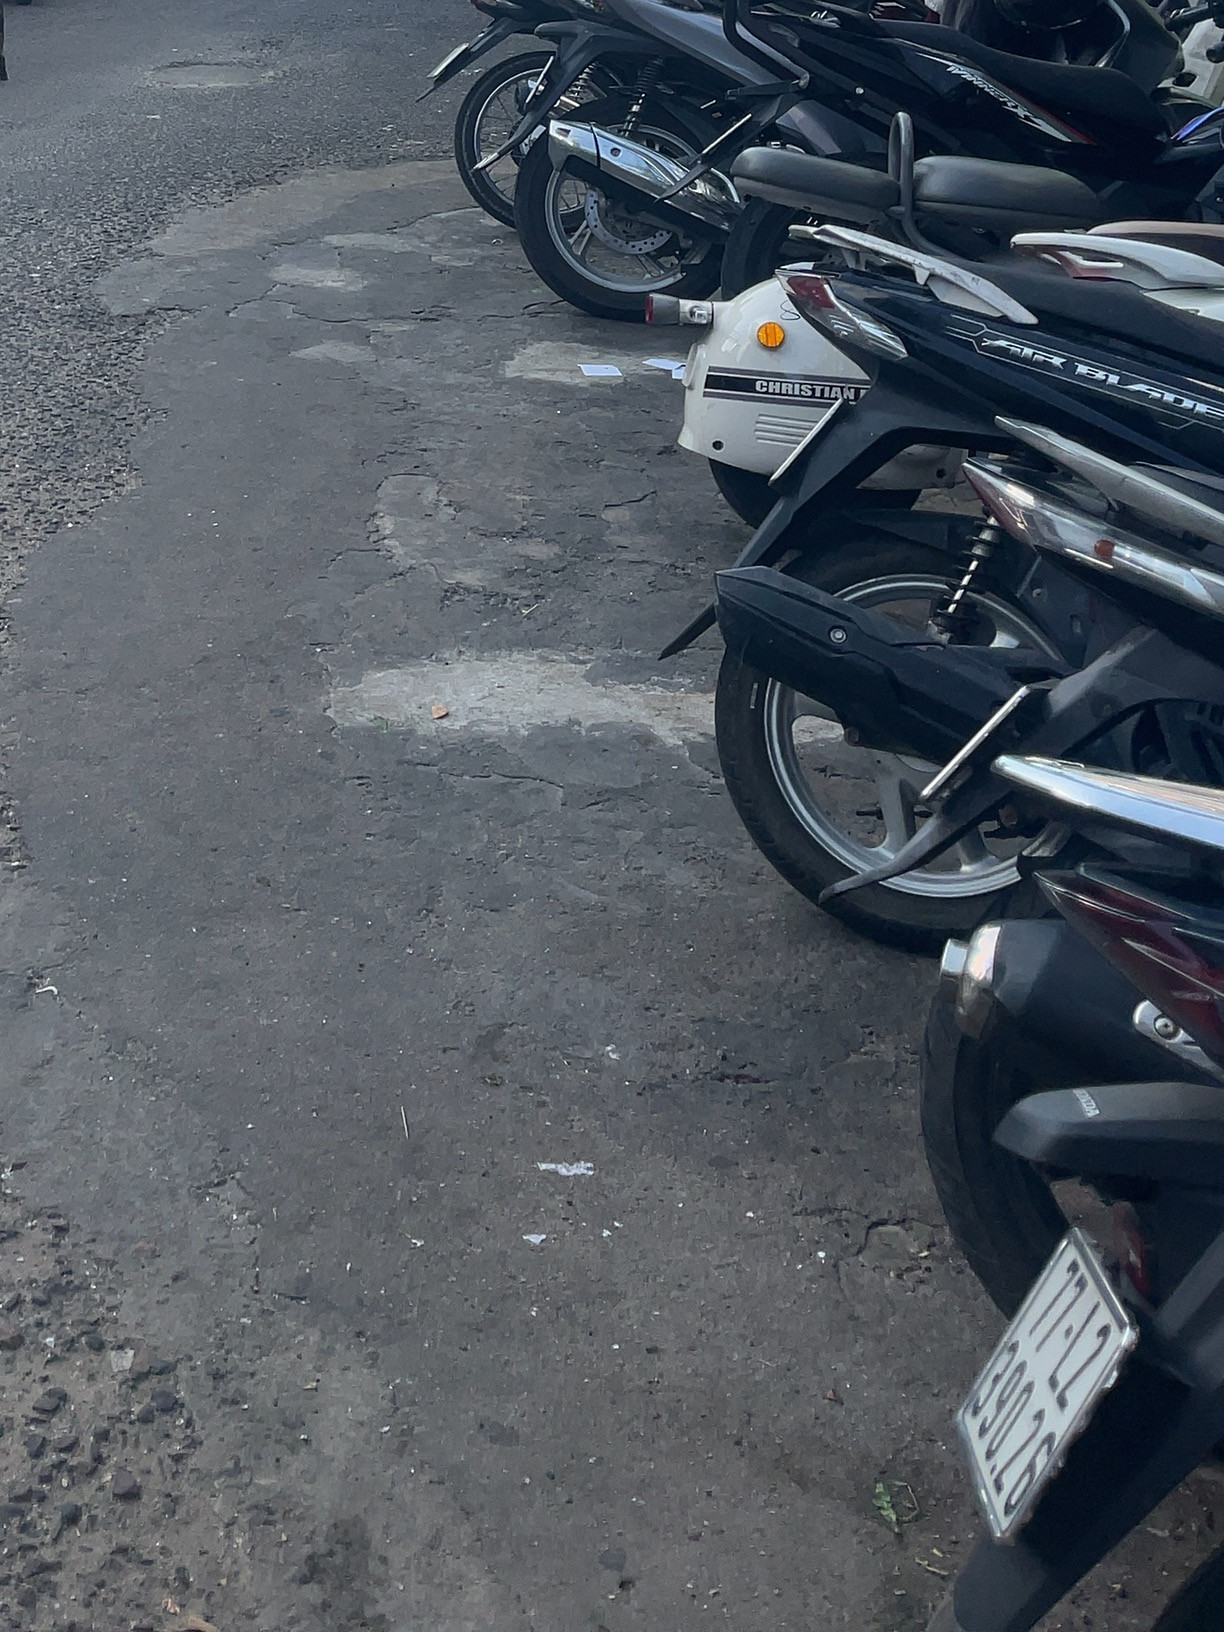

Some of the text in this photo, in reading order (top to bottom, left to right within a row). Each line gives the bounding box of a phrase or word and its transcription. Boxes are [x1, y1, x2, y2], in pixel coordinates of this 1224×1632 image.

[755, 380, 855, 400] CHRISTIAN
[980, 337, 1068, 370] AIR
[1028, 1257, 1112, 1413] 77-L2
[971, 1339, 1057, 1518] 390.26
